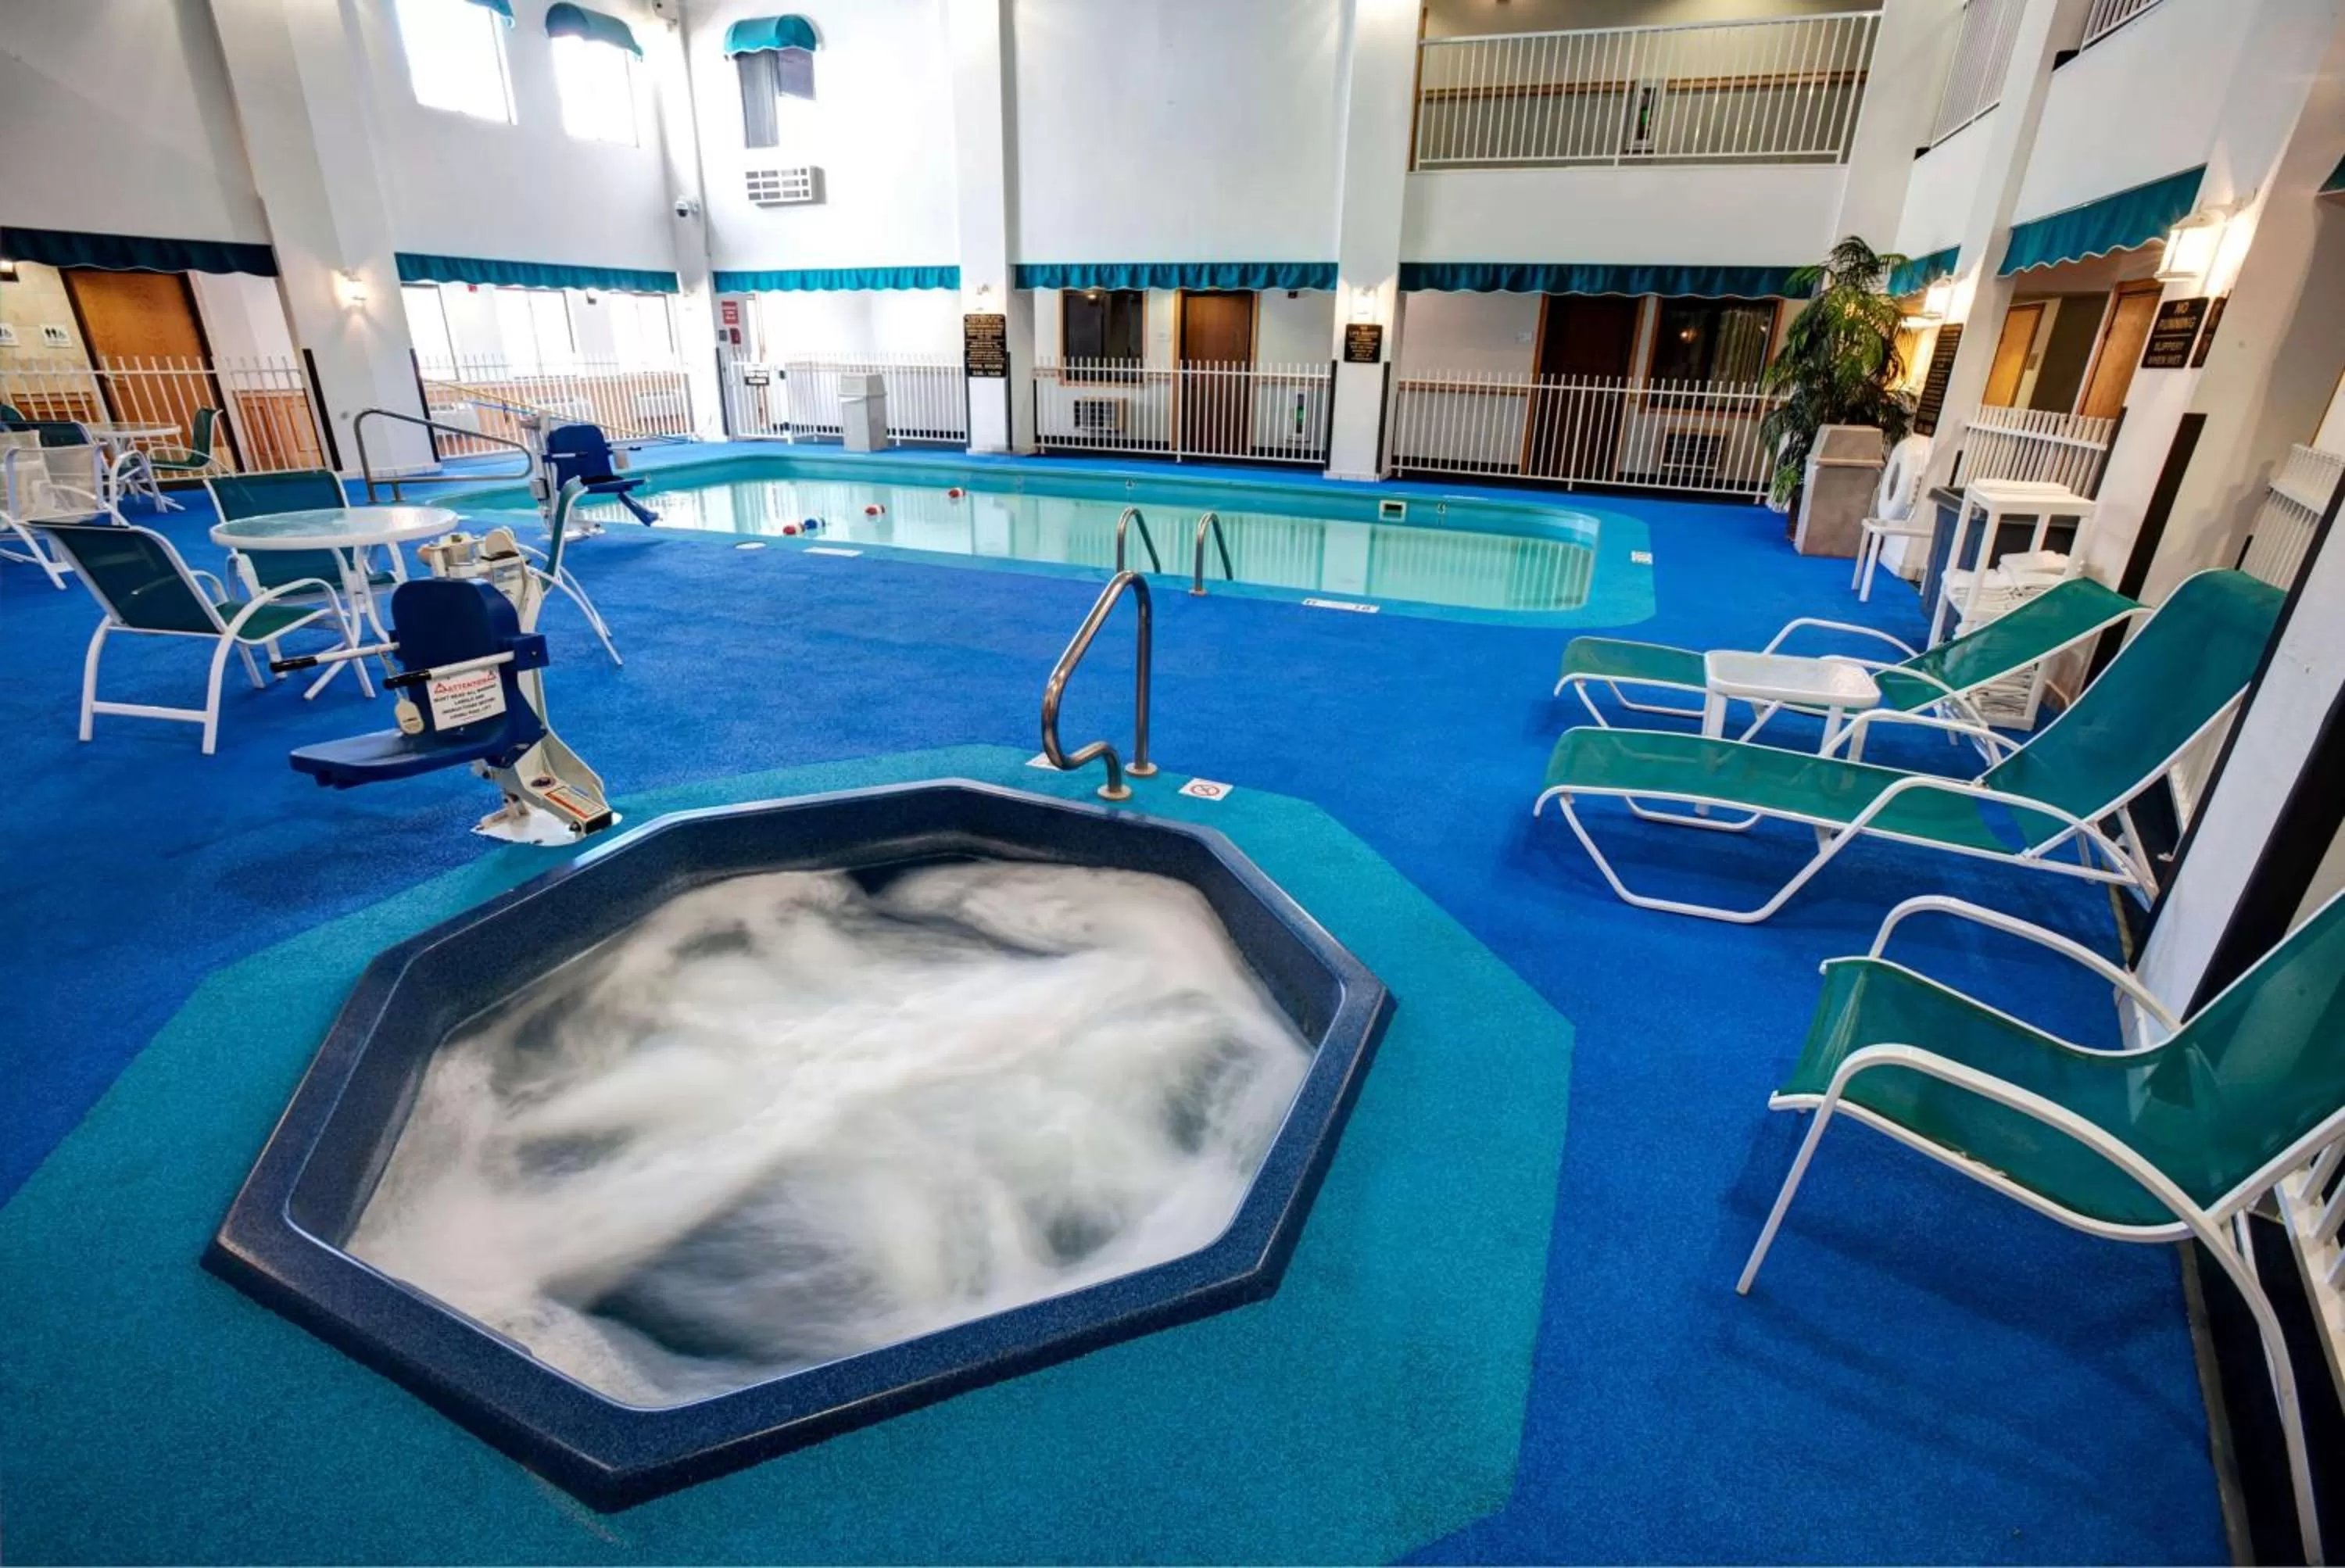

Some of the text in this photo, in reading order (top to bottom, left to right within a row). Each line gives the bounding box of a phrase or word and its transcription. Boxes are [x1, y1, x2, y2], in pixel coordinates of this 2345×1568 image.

[2175, 301, 2189, 314] NO
[2158, 315, 2196, 330] RUNNING
[447, 678, 486, 692] ATTENTION
